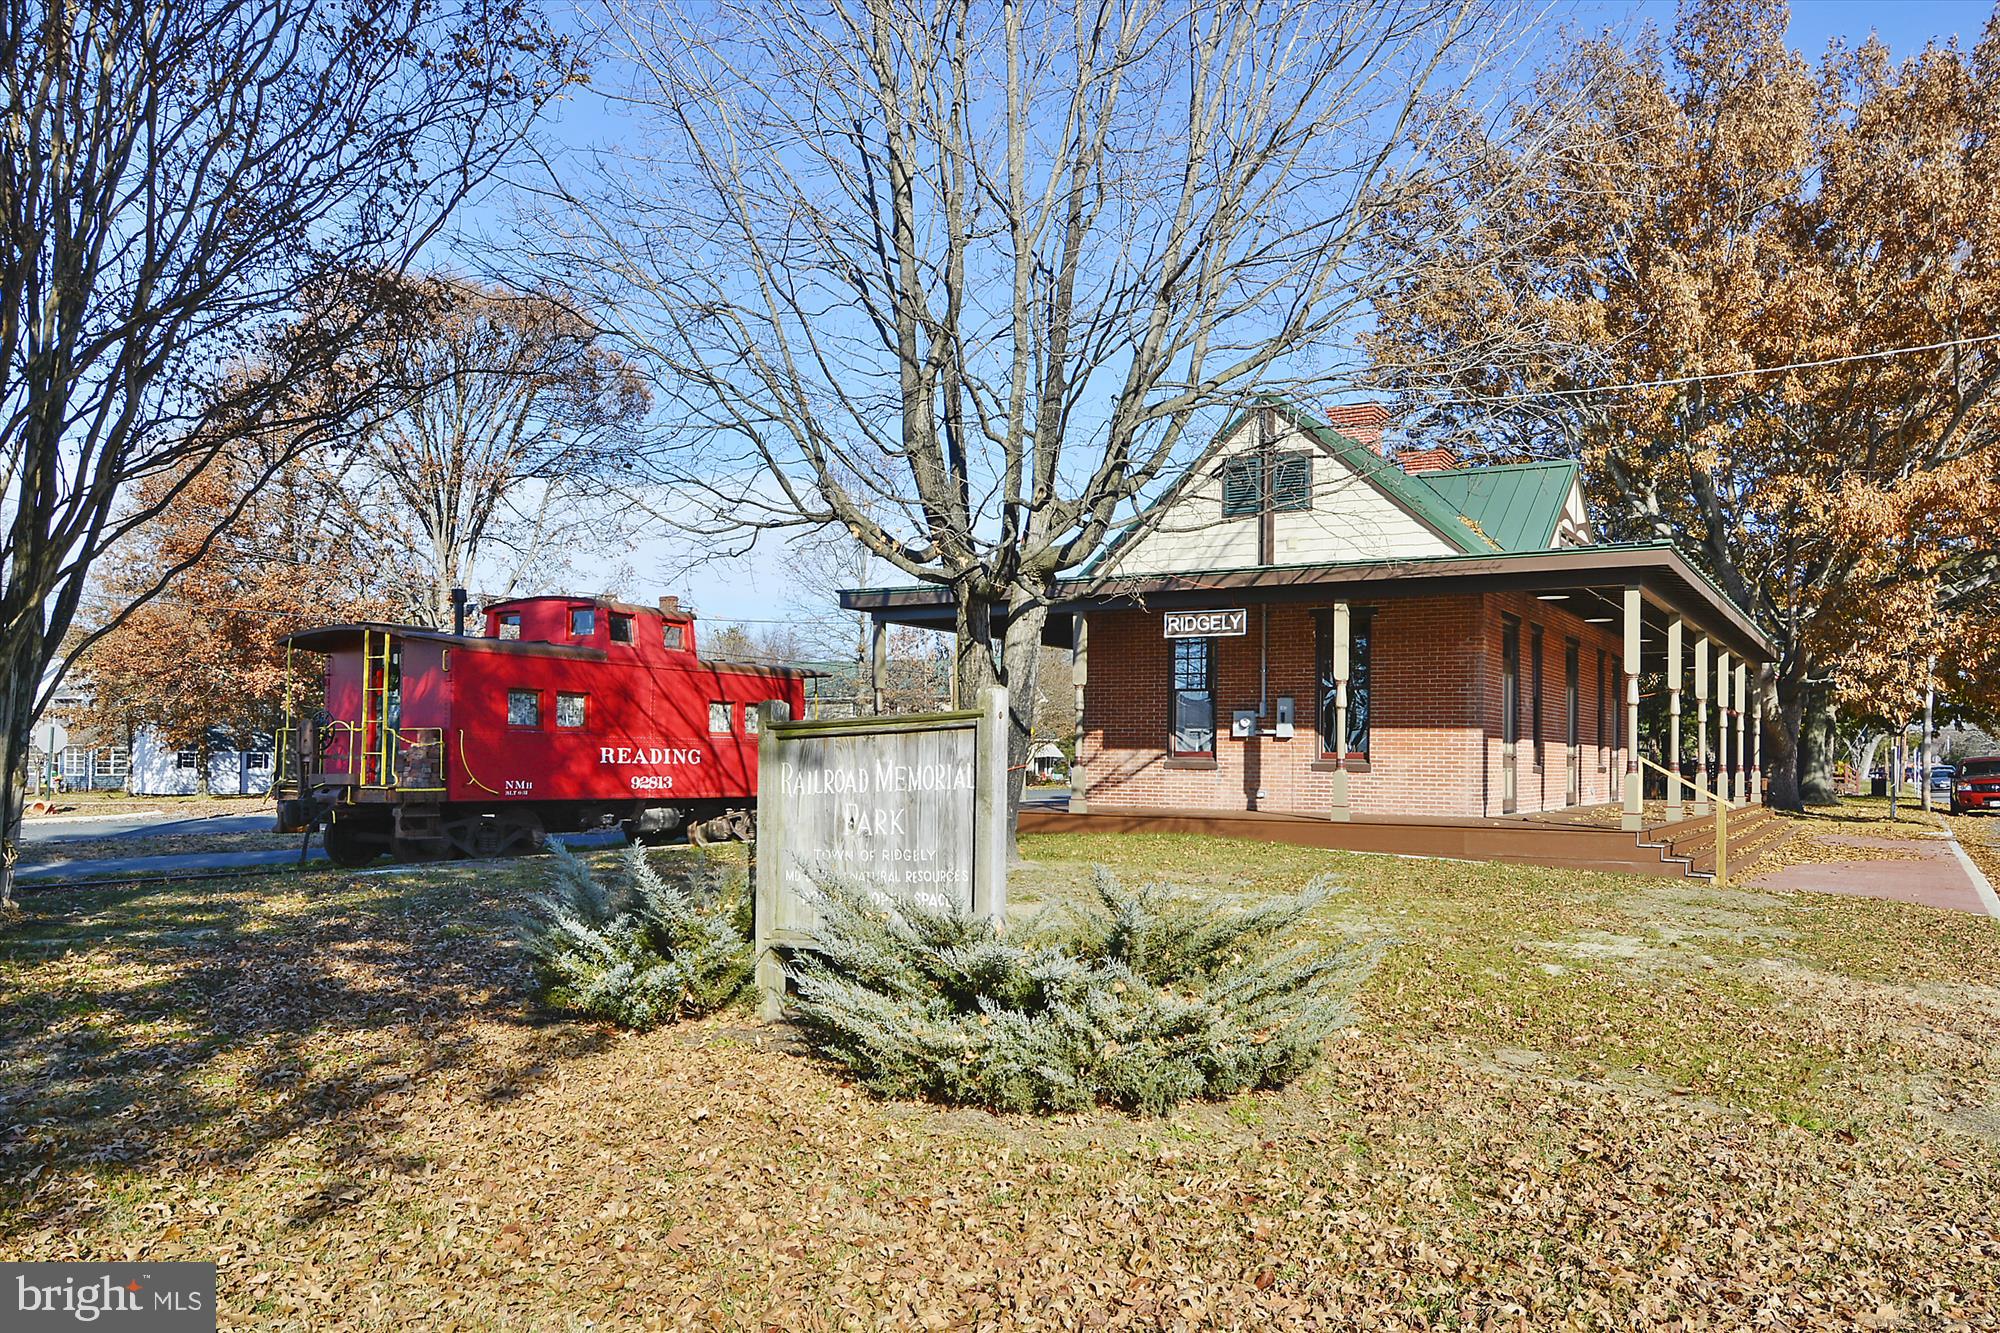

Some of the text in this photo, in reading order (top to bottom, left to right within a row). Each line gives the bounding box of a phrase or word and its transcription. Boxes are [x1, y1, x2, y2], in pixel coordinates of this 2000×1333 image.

[1167, 614, 1243, 632] RIDGELY
[600, 747, 701, 765] READING
[631, 775, 673, 790] 92813
[780, 759, 975, 798] RAILROAD MEMORIAL
[843, 803, 905, 836] PARK
[813, 848, 937, 862] TOWN OF RIDGELY
[905, 868, 969, 883] RESOURCES
